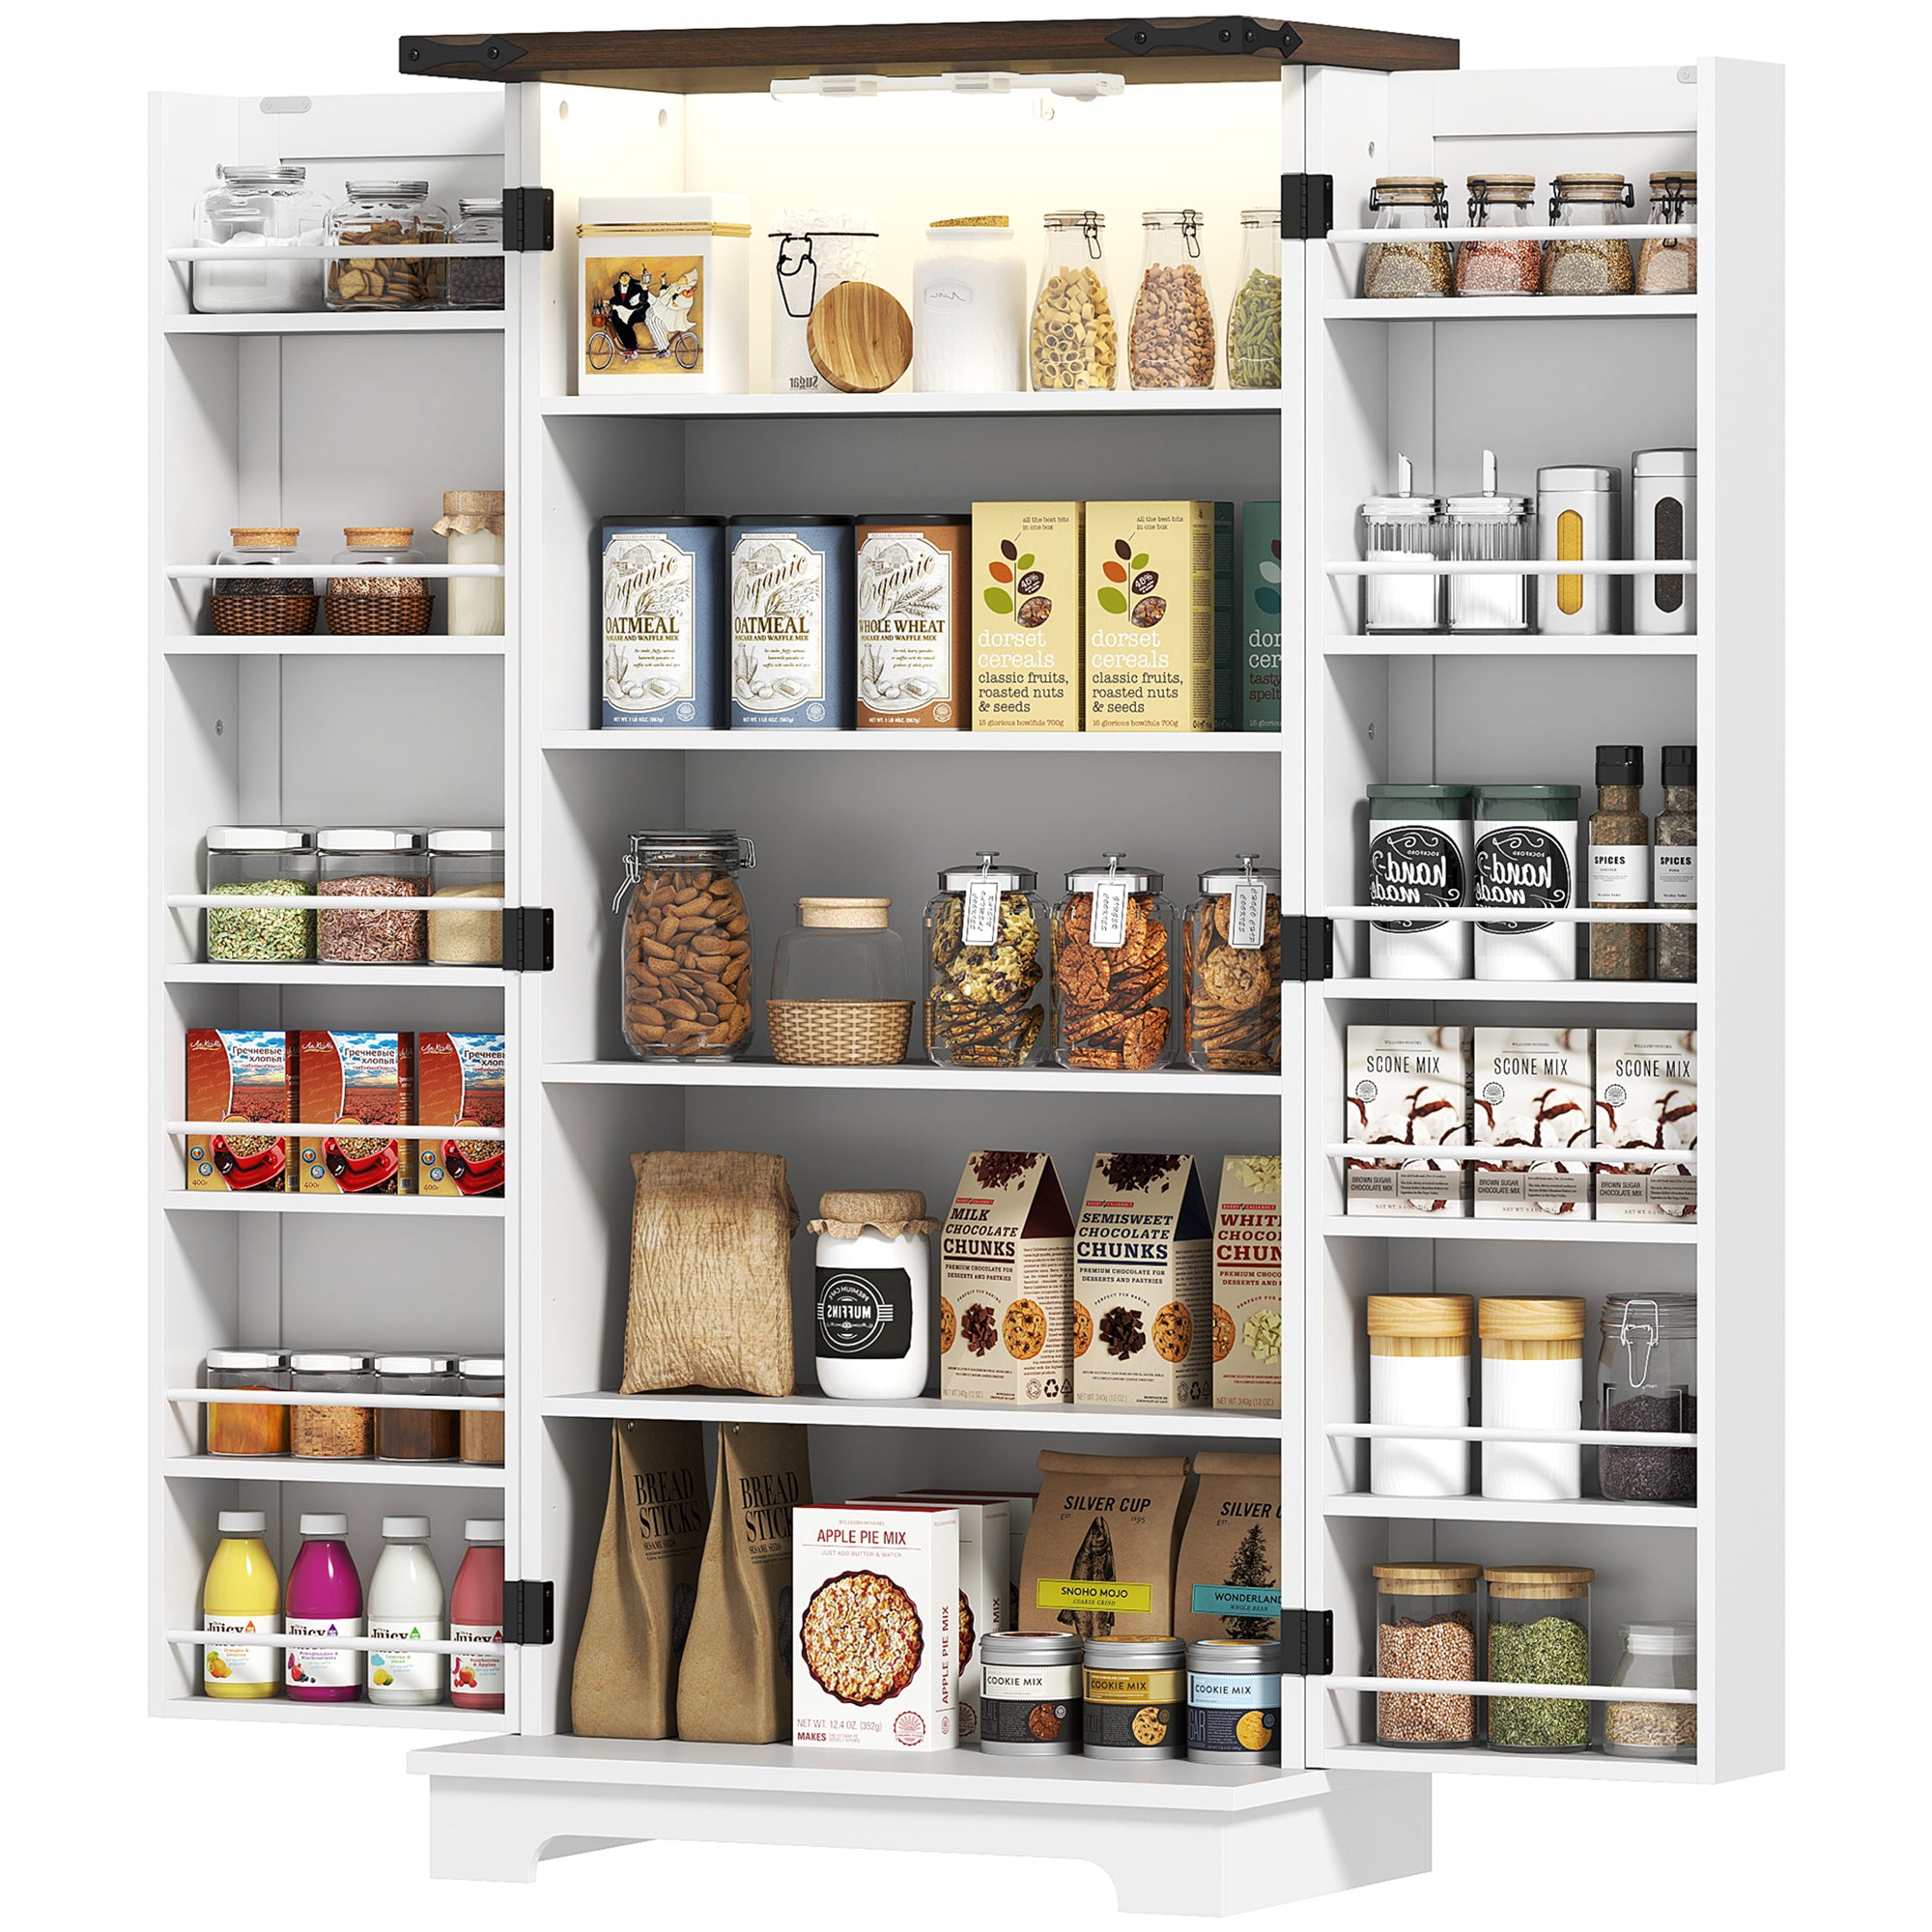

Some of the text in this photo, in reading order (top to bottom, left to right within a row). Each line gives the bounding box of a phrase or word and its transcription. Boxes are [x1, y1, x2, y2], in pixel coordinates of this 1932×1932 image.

[605, 555, 678, 614] Organic
[734, 554, 808, 614] Organic
[860, 554, 935, 614] Organic
[606, 617, 679, 634] OATMEAL
[734, 616, 810, 634] OATMEAL
[859, 619, 946, 633] WHOLE WHEAT
[978, 629, 1046, 647] dorset
[1092, 629, 1161, 647] dorset
[978, 650, 1055, 668] cereals
[1092, 650, 1169, 668] cereals
[979, 672, 1069, 685] classic fruits,
[1092, 672, 1183, 685] classic fruits,
[979, 687, 1065, 698] roasted nuts
[1092, 687, 1179, 698] roasted nuts
[979, 700, 1031, 712] & seeds
[1093, 701, 1145, 713] & seeds
[1594, 856, 1626, 865] SPICES
[1660, 857, 1691, 866] SPICES
[232, 1046, 282, 1056] Гречневые
[344, 1048, 395, 1058] Гречневые
[1367, 1056, 1440, 1073] SCONE MIX
[1493, 1058, 1568, 1076] SCONE MIX
[1616, 1060, 1690, 1077] SCONE MIX
[951, 1208, 990, 1221] MILK
[1082, 1213, 1174, 1226] SEMISWEET
[946, 1224, 1018, 1236] CHOCOLATE
[1079, 1227, 1170, 1239] CHOCOLATE
[944, 1238, 1015, 1257] CHUNKS
[1077, 1241, 1168, 1260] CHUNKS
[1216, 1244, 1282, 1261] CHUN
[634, 1468, 695, 1506] BREAD
[739, 1471, 799, 1510] BREAD
[1064, 1495, 1151, 1513] SILVER CUP
[1220, 1501, 1272, 1519] SILVER
[639, 1500, 702, 1539] STICKS
[745, 1505, 793, 1543] STICK
[817, 1528, 906, 1546] APPLE PIE MIX
[1061, 1586, 1128, 1598] SNOHO MOJO
[987, 1676, 1043, 1687] COOKIE MIX
[1092, 1681, 1147, 1690] COOKIE MIX
[1195, 1684, 1229, 1694] COOKIE
[797, 1719, 883, 1733] NET WT. 12.4 OZ. (352g)
[797, 1732, 827, 1742] MAKES
